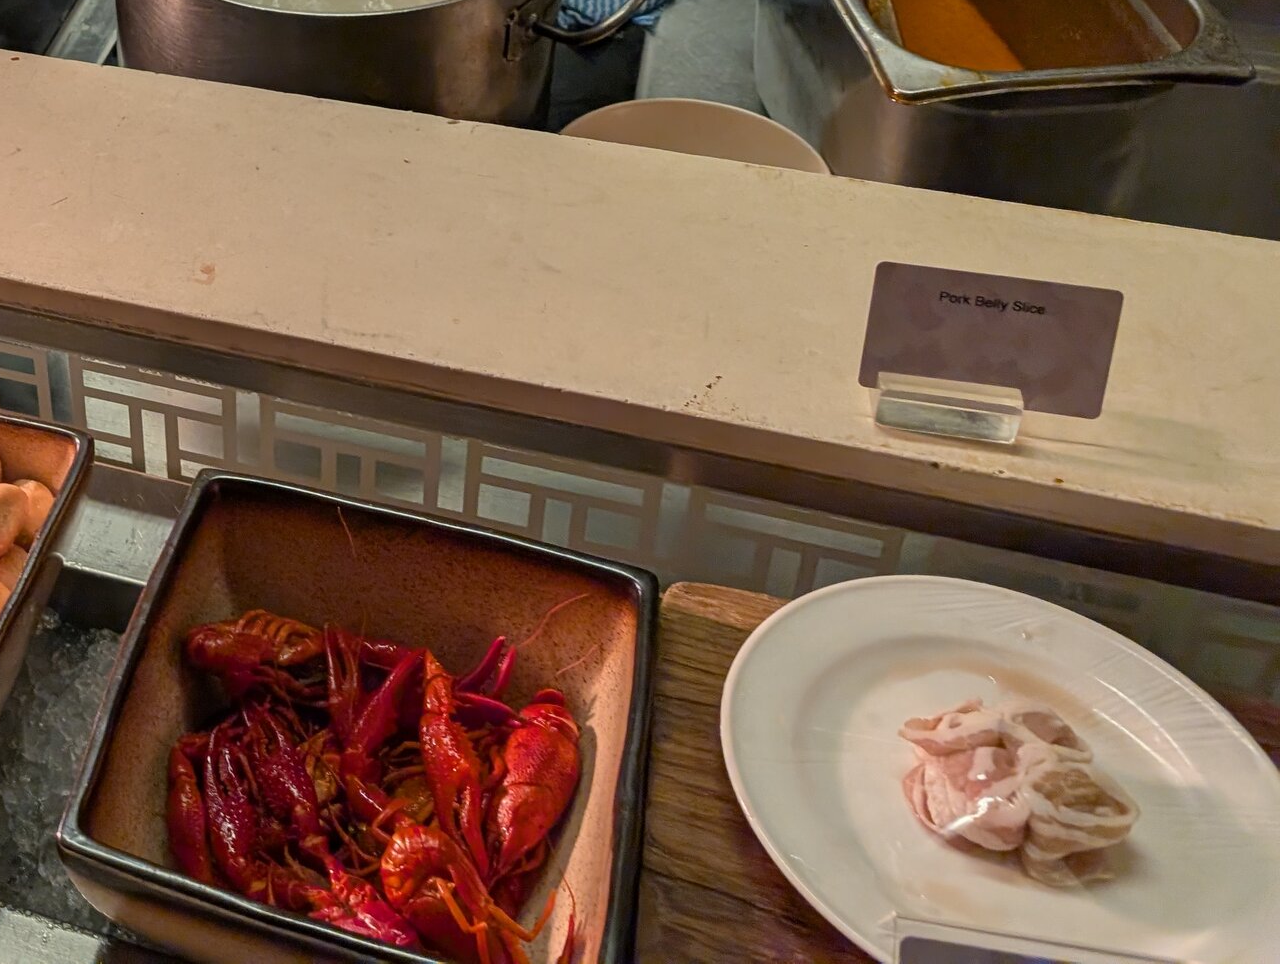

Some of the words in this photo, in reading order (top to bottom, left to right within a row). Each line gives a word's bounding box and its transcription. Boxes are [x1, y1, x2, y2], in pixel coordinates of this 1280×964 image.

[939, 291, 971, 305] Pork
[975, 296, 1008, 312] Belly
[1012, 300, 1046, 315] Slice
